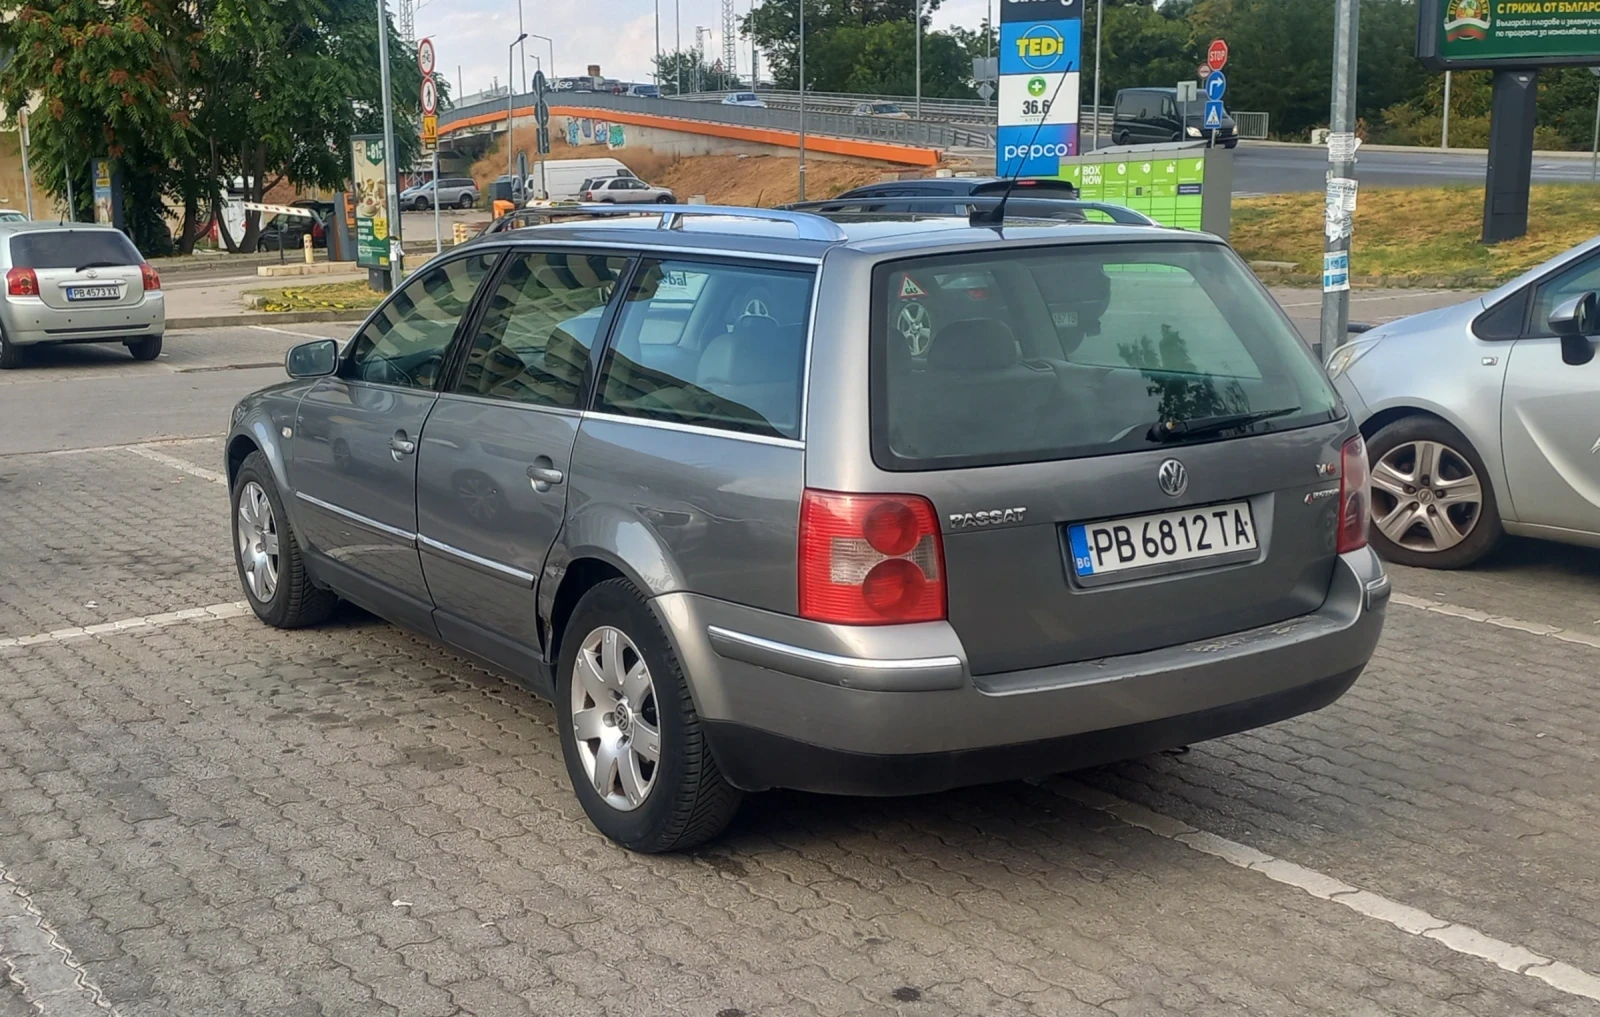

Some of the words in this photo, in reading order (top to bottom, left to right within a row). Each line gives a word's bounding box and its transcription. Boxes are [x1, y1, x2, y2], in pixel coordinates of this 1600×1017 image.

[1497, 3, 1505, 14] С
[1506, 2, 1542, 14] ГРИЖА
[1543, 2, 1557, 13] ОТ
[1016, 37, 1064, 57] TEDi
[1209, 50, 1226, 62] STOP
[1022, 99, 1051, 115] 36.6
[1004, 143, 1068, 161] pepco
[1082, 165, 1101, 176] BOX
[1081, 175, 1102, 185] NOW
[73, 289, 85, 298] PB
[86, 288, 106, 297] 4573
[949, 507, 1027, 529] PASSAT
[1092, 525, 1136, 567] PB
[1142, 514, 1212, 558] 6812
[1212, 509, 1250, 547] TA
[1076, 556, 1091, 570] BG
